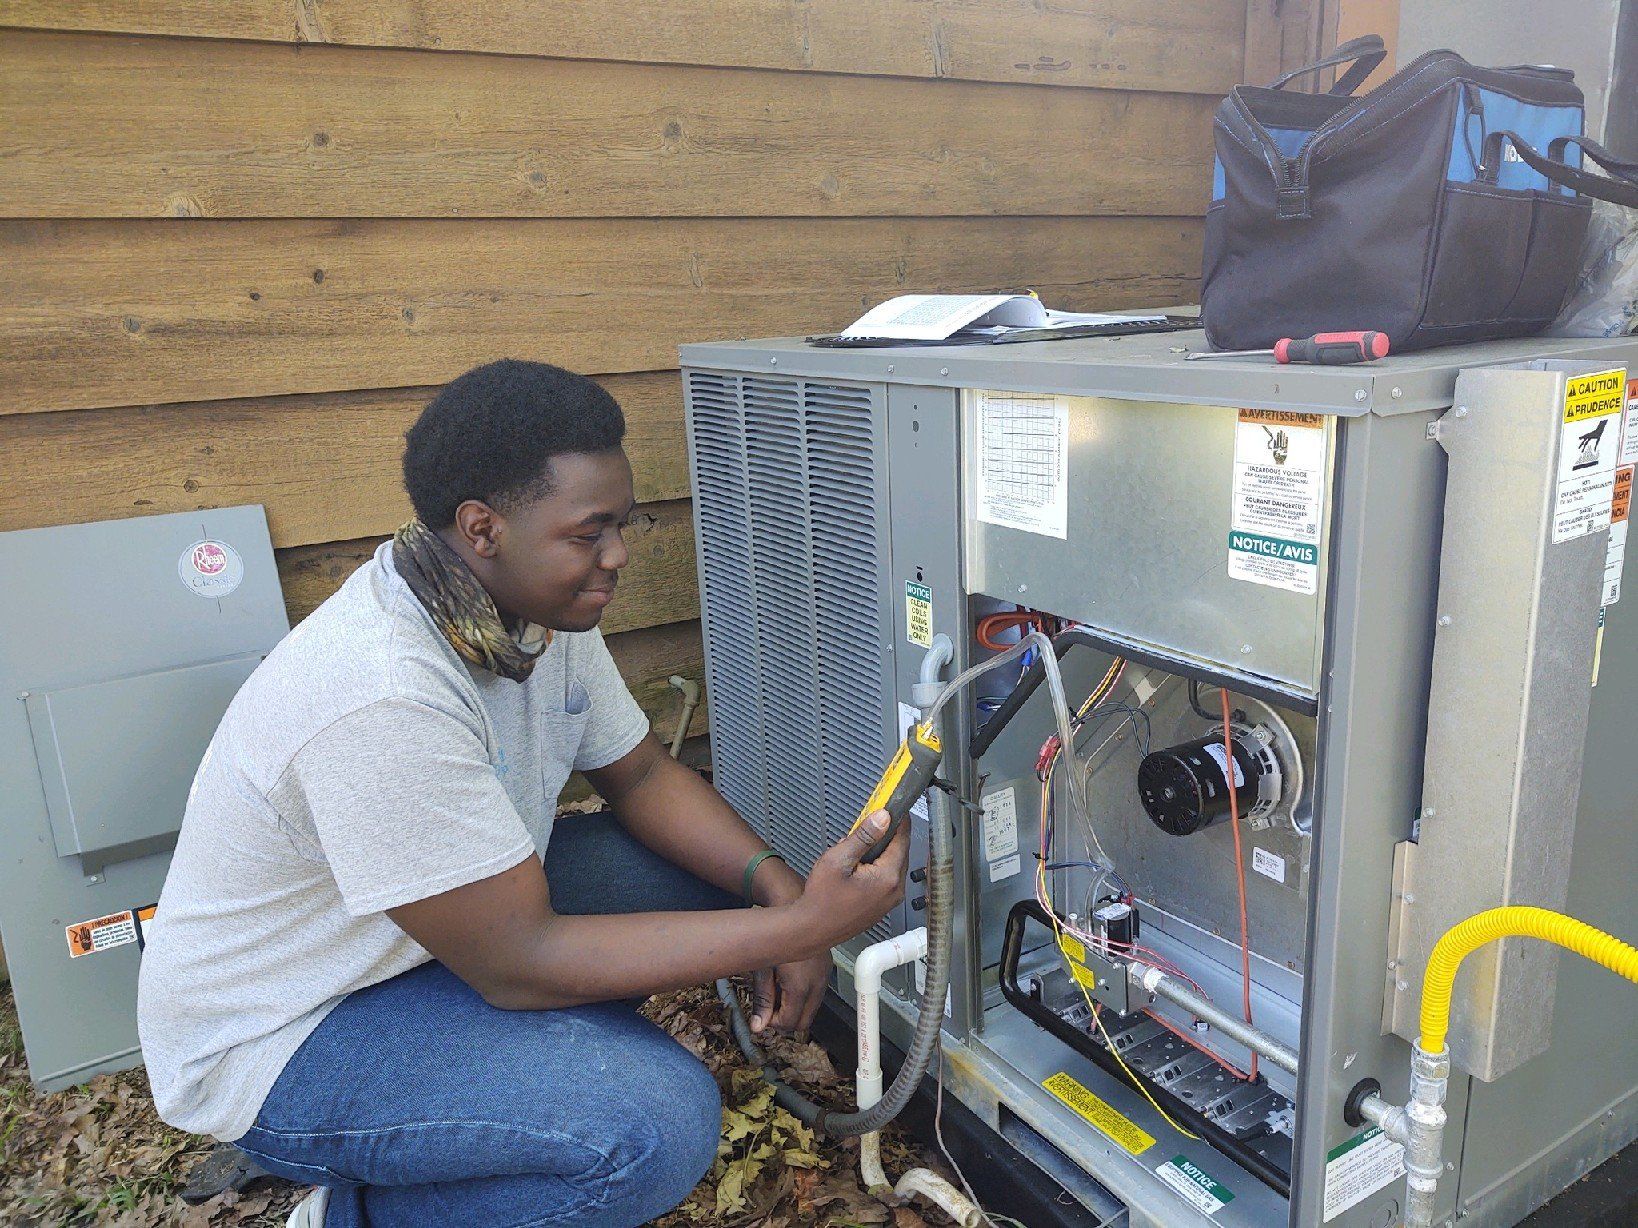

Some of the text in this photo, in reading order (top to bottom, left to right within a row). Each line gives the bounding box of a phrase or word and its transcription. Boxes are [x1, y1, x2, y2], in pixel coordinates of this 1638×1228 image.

[1578, 377, 1619, 395] CAUTION
[1575, 397, 1621, 414] PRUDENCE
[1248, 408, 1324, 424] AVERTISSEMENT
[1245, 496, 1271, 505] COURANT
[1271, 500, 1306, 511] DANGEREUX
[1233, 535, 1313, 561] NOTICE/AVIS
[194, 547, 226, 571] Rheem
[908, 583, 930, 599] NOTICE
[911, 599, 928, 609] CLEAN
[911, 623, 928, 635] WATER
[913, 632, 926, 641] ONLY
[1181, 1162, 1217, 1190] NOTICE
